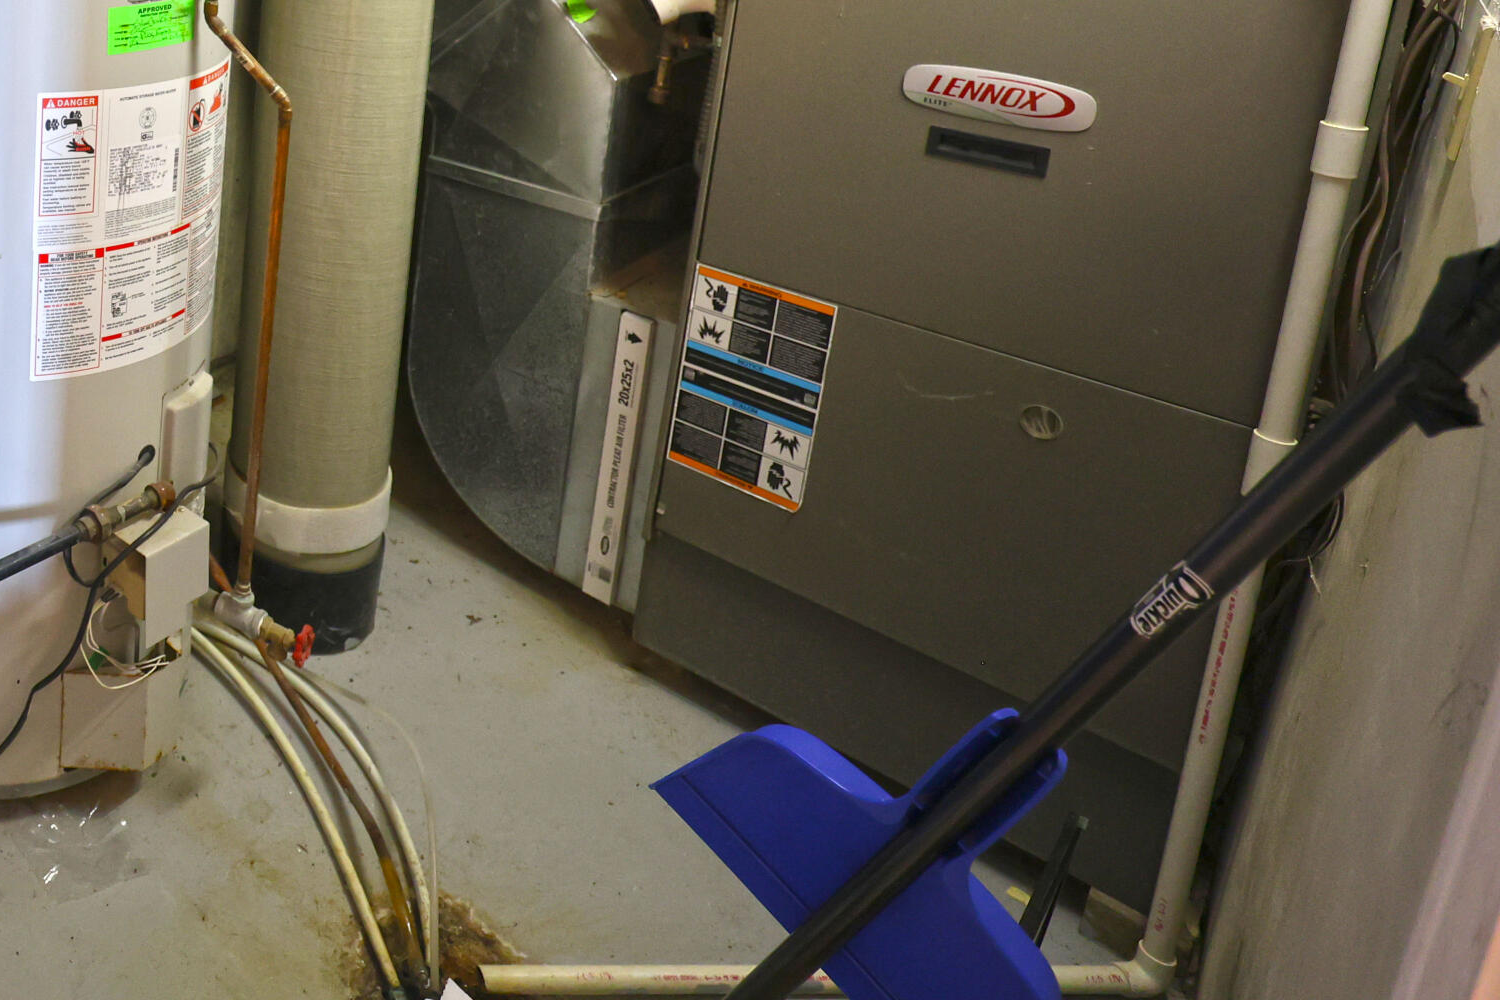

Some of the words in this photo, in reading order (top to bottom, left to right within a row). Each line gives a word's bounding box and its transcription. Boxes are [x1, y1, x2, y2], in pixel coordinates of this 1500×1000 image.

[138, 4, 172, 14] APPROVED
[927, 75, 1047, 112] LENNOX
[57, 98, 95, 107] DANGER
[924, 97, 947, 107] ELITE
[618, 358, 635, 407] 20x25x2
[617, 414, 627, 436] FILTER
[615, 436, 624, 448] AIR
[612, 448, 622, 467] PLEAT
